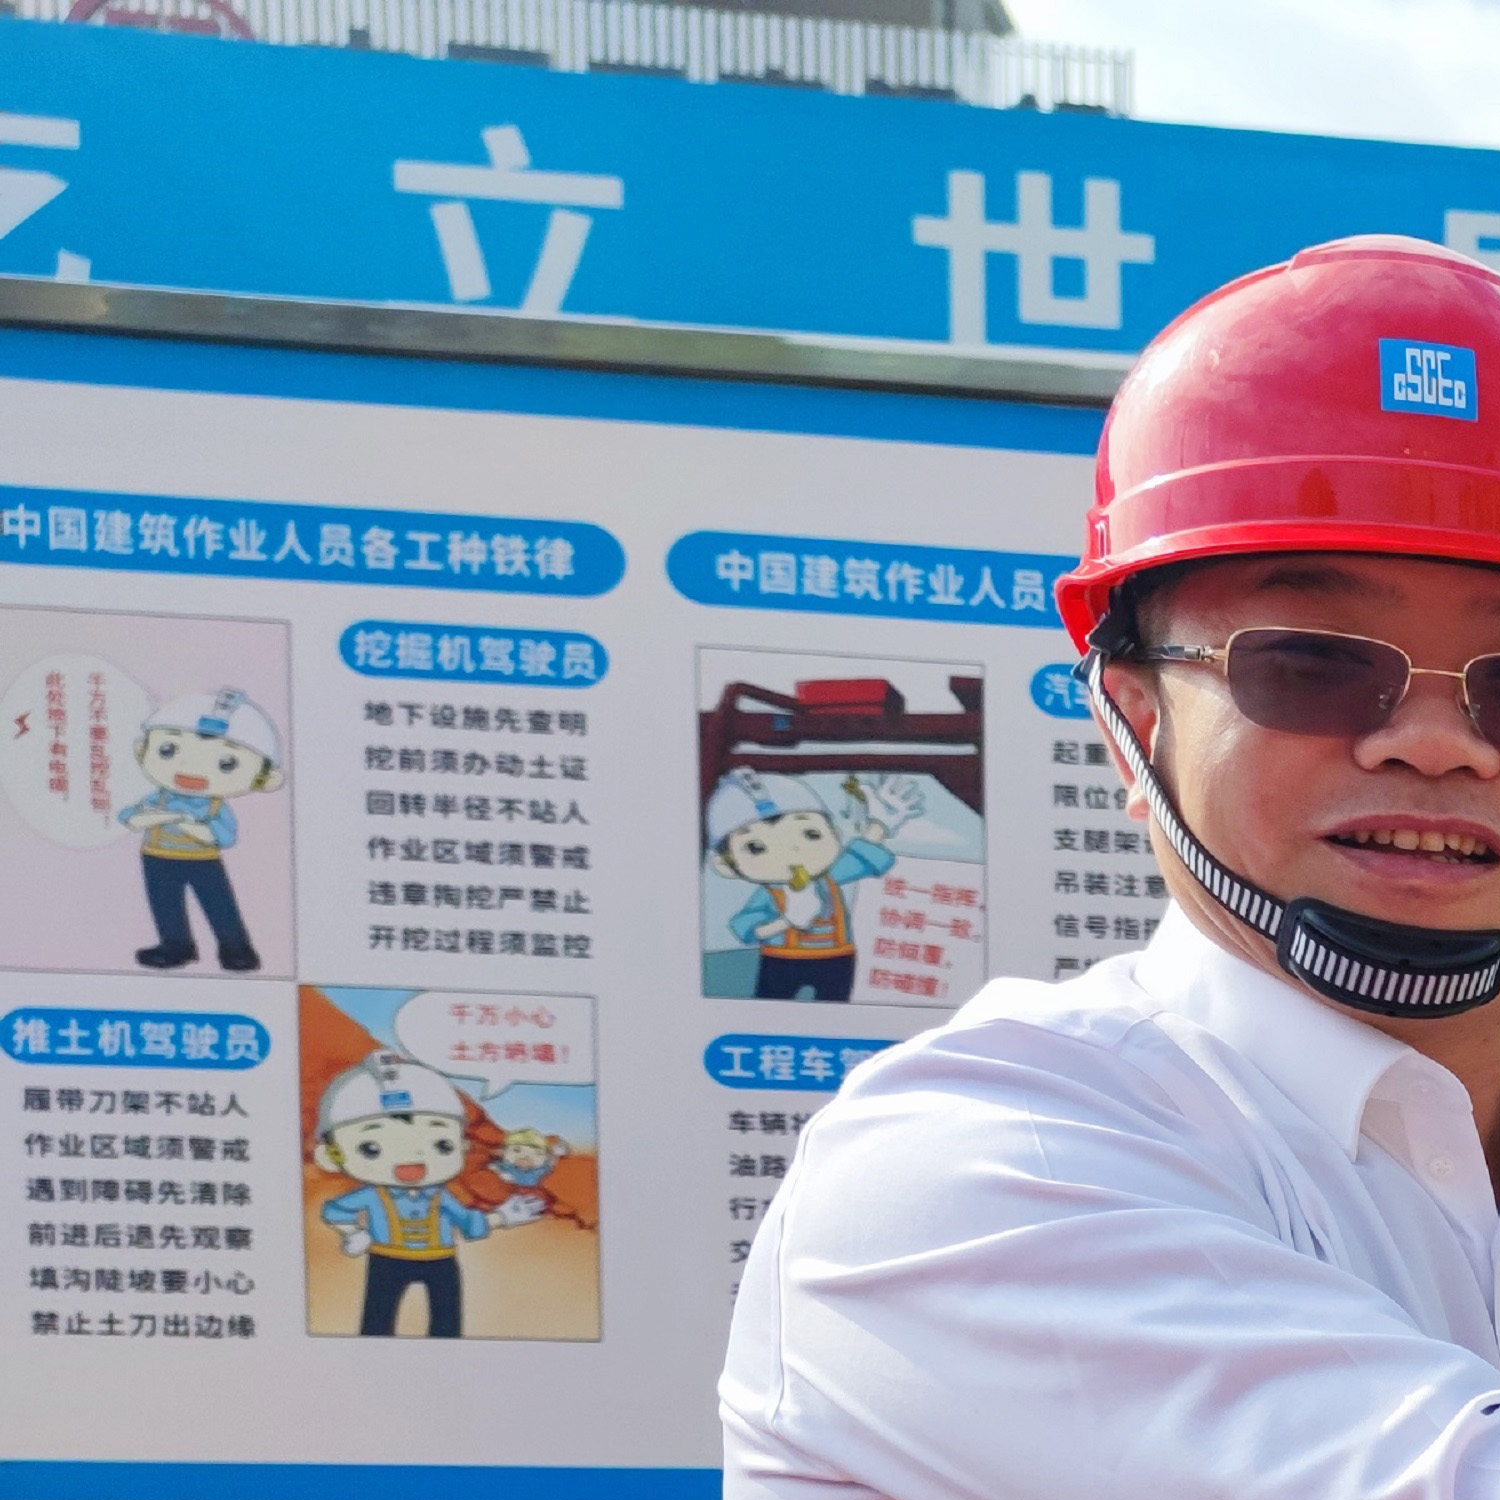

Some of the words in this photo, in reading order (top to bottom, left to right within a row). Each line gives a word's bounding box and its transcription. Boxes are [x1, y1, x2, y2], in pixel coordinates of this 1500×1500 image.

[0, 506, 576, 580] 中国建筑作业人员各工种铁律
[714, 550, 1058, 614] 中国建筑作业人员
[354, 630, 598, 681] 挖掘机驾驶员
[363, 700, 588, 737] 地下设施先查明
[364, 745, 589, 782] 挖前须办动土证
[365, 789, 590, 825] 回转半径不站人
[366, 836, 590, 871] 作业区域须警戒
[367, 880, 591, 915] 违章掏挖严禁止
[368, 924, 592, 960] 开挖过程须监控
[448, 1002, 558, 1030] 千万小心
[15, 1019, 257, 1060] 推土机驾驶员
[22, 1086, 248, 1117] 履带刀架不站人
[23, 1132, 251, 1163] 作业区域须警戒
[25, 1176, 251, 1207] 遇到障碍先清除
[27, 1222, 253, 1251] 前进后退先观察
[29, 1266, 256, 1296] 填沟陡坡要小心
[31, 1310, 256, 1340] 禁止土刀出边缘
